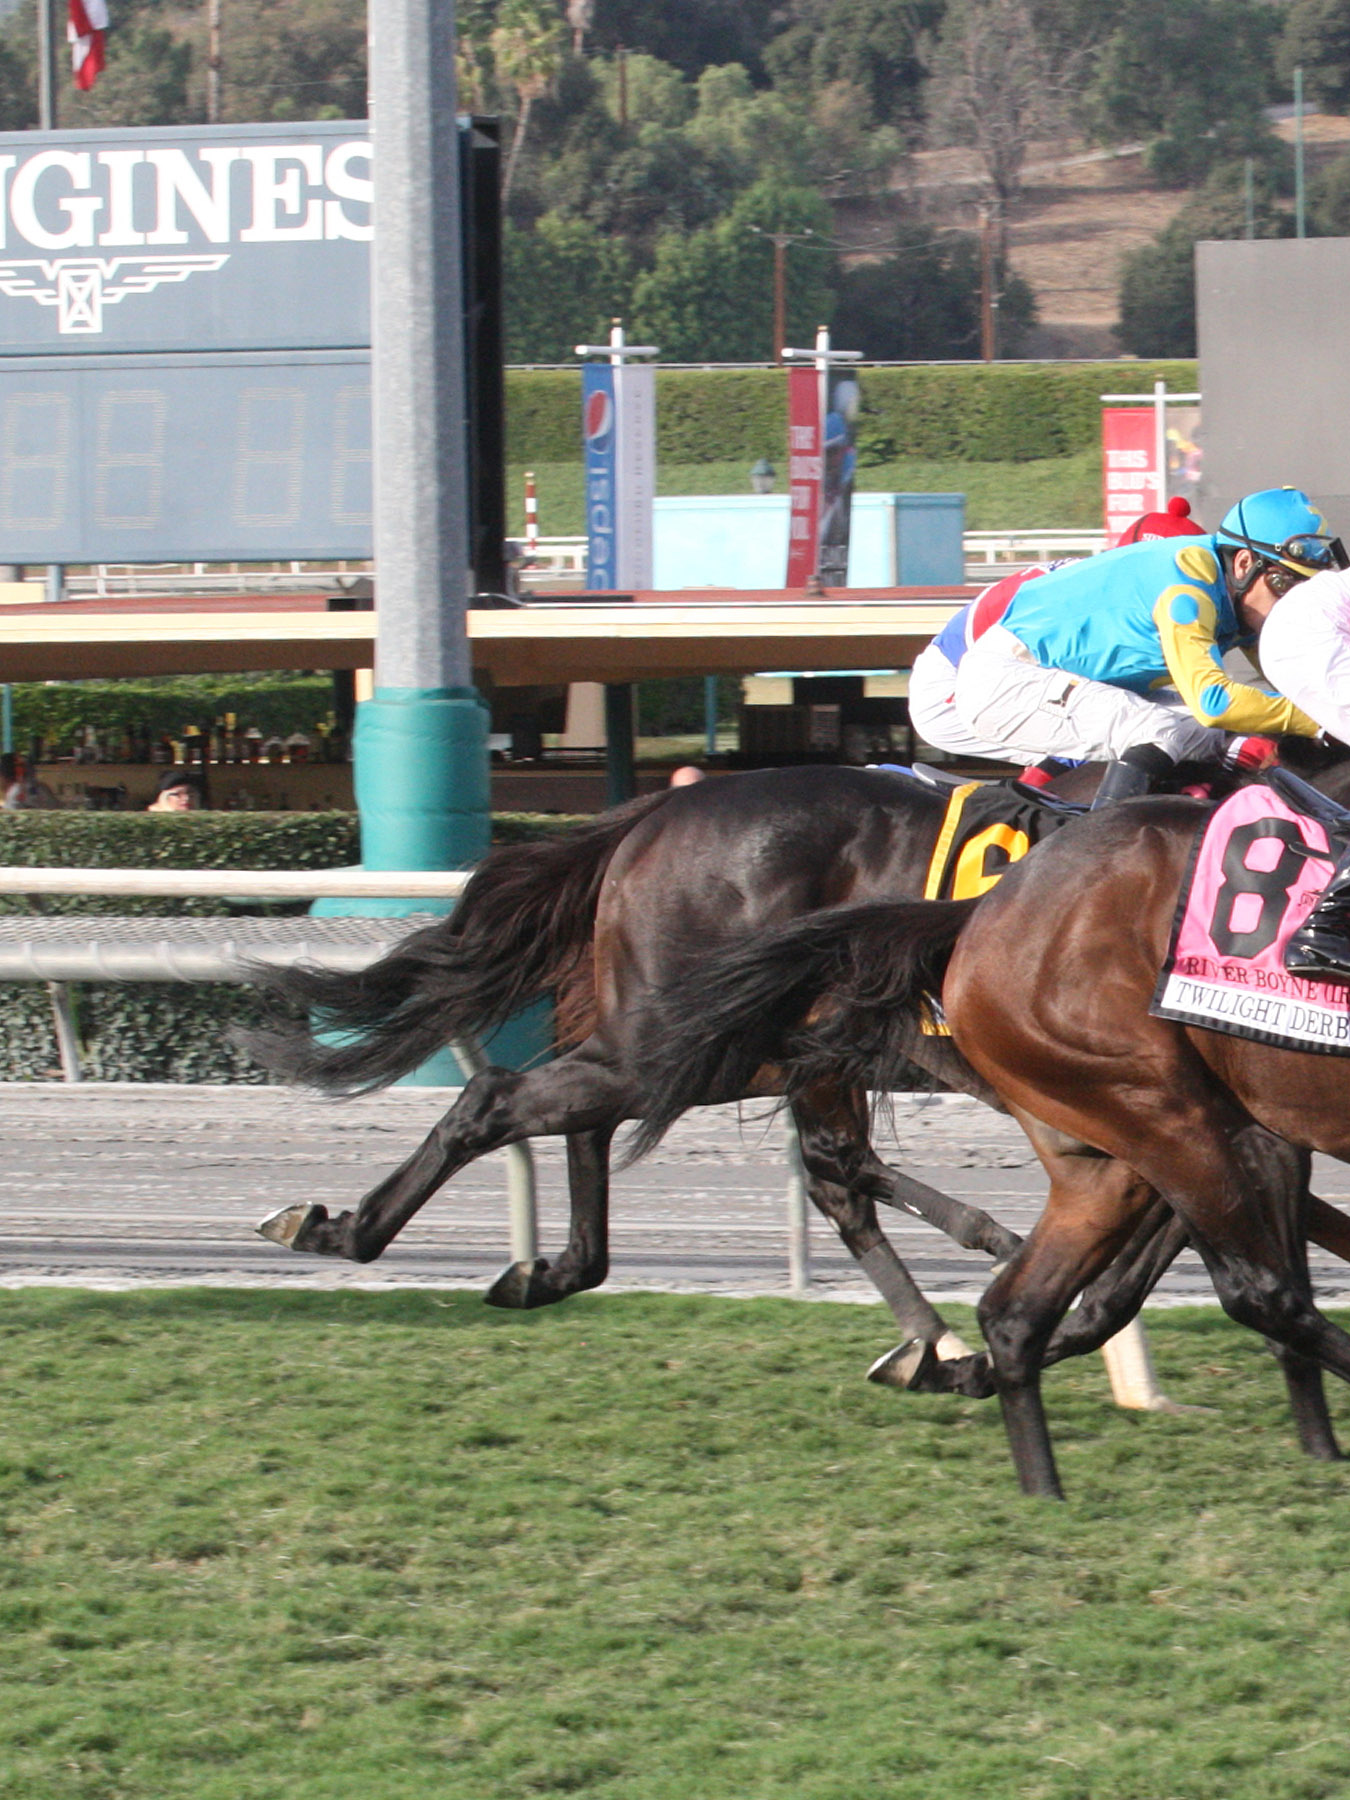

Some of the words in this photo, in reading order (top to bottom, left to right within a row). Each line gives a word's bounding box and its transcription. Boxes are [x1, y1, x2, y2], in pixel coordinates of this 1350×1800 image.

[0, 141, 373, 250] GINES
[1209, 817, 1307, 960] 8
[1176, 981, 1287, 1026] TWILIGHT
[1185, 956, 1249, 985] RIVER
[1254, 968, 1319, 1001] BOYNE
